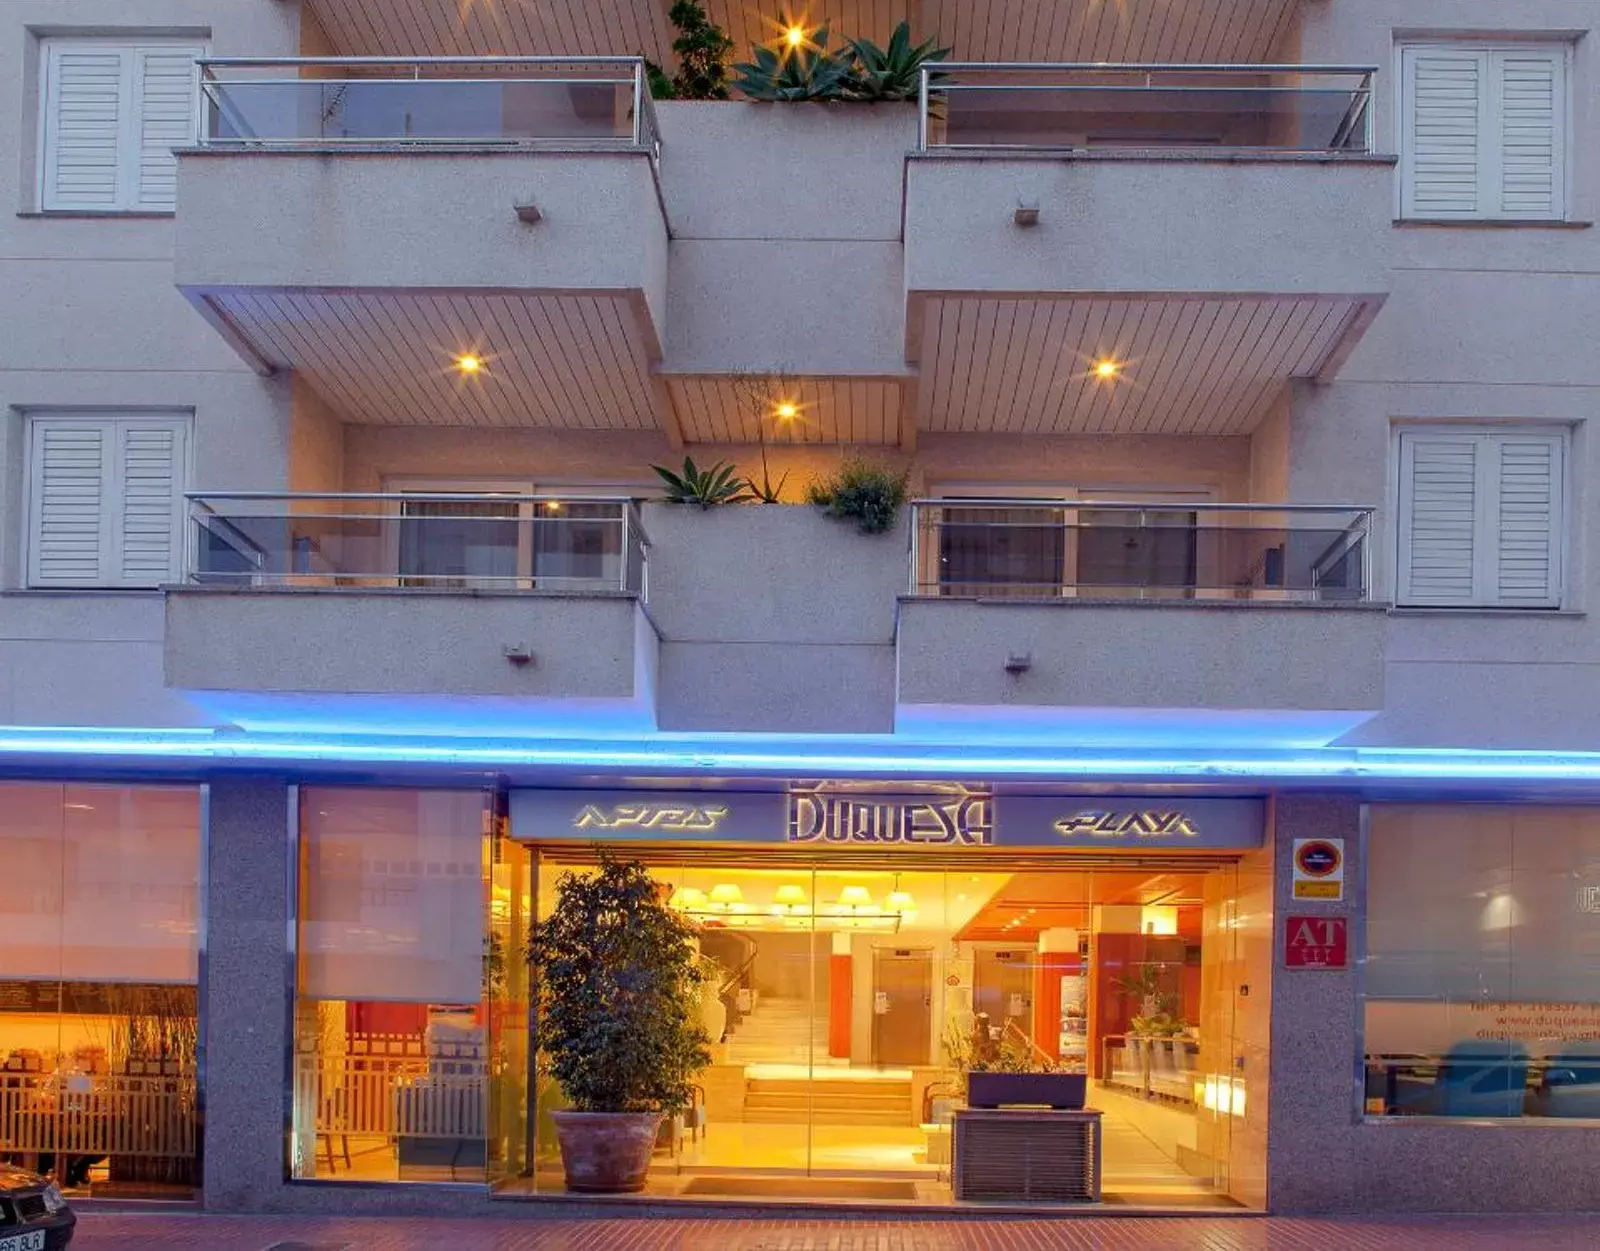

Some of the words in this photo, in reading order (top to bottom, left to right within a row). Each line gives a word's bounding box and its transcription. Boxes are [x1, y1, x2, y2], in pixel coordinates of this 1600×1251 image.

[788, 781, 993, 845] DUQUESA
[1054, 811, 1200, 836] PLAYA
[1291, 919, 1344, 946] AT
